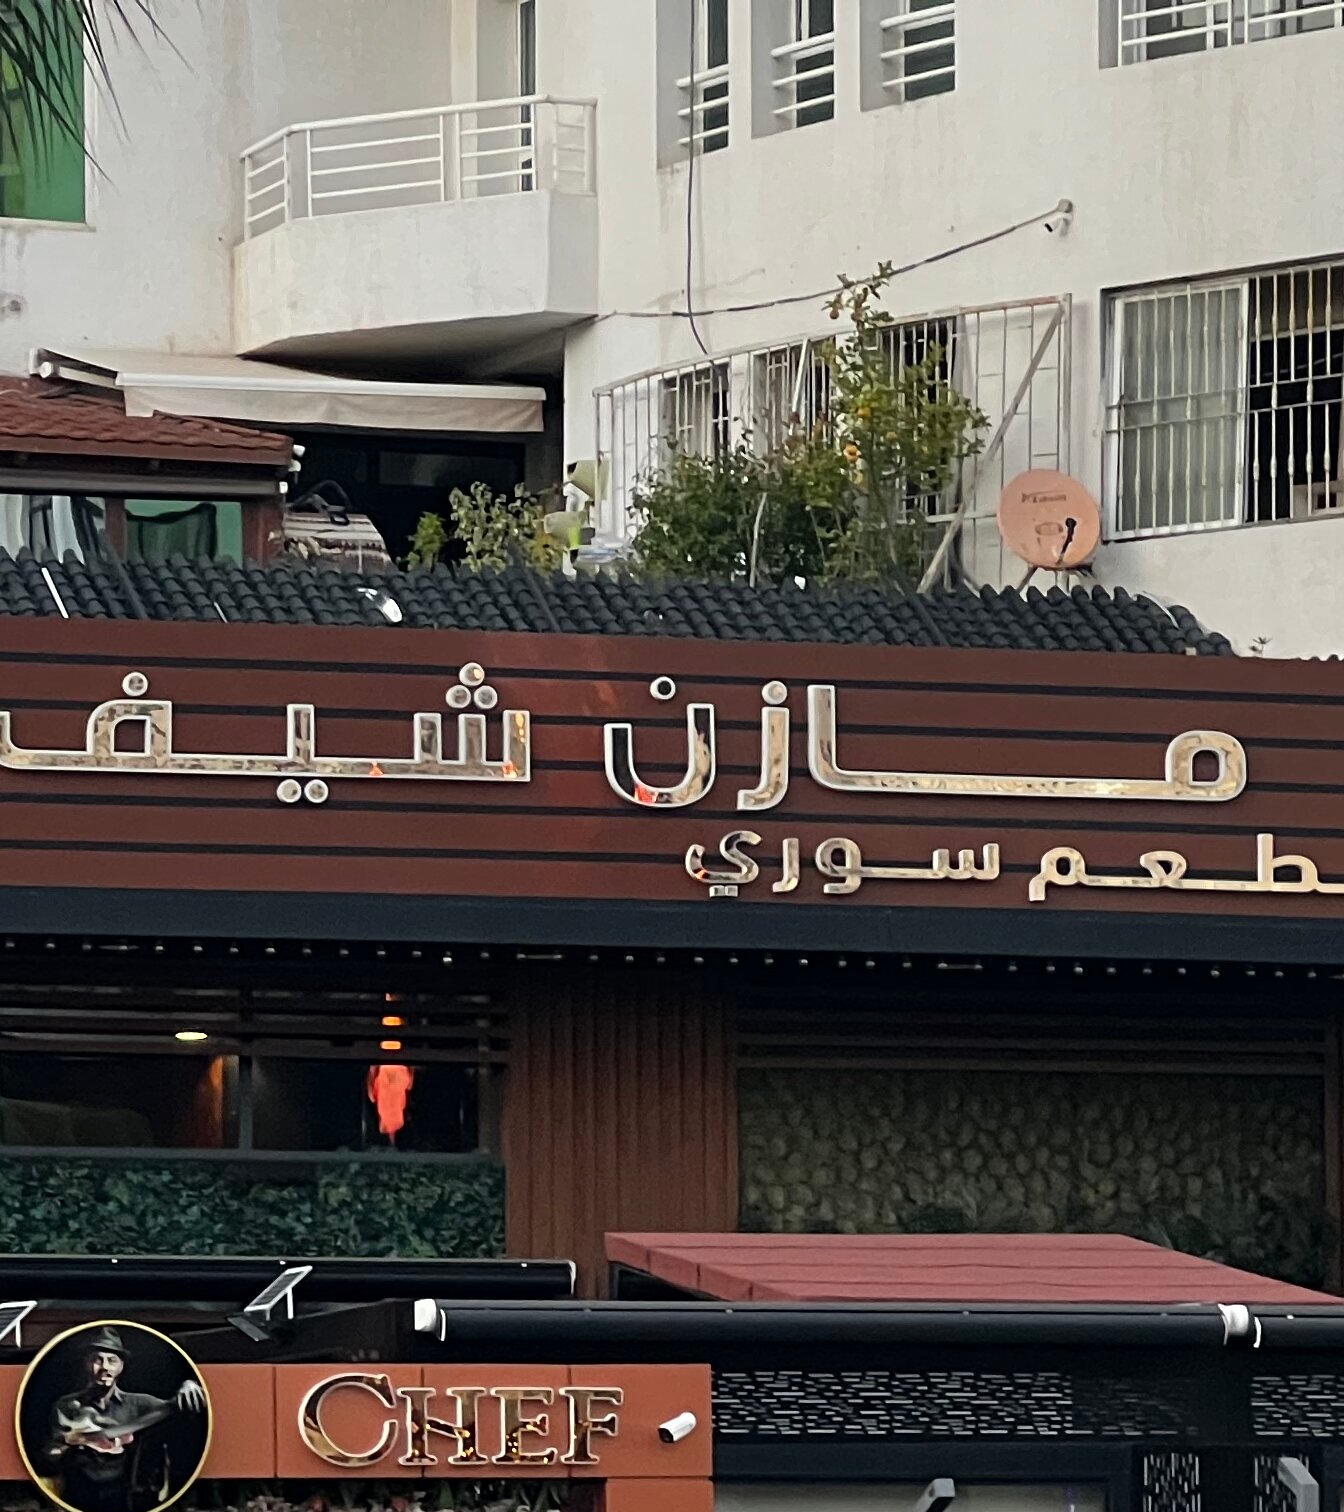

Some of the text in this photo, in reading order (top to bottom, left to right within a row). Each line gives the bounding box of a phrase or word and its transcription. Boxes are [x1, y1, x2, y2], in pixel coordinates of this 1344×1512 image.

[603, 677, 1248, 808] مازن
[685, 830, 1000, 898] سوري
[297, 1372, 624, 1467] CHEF
